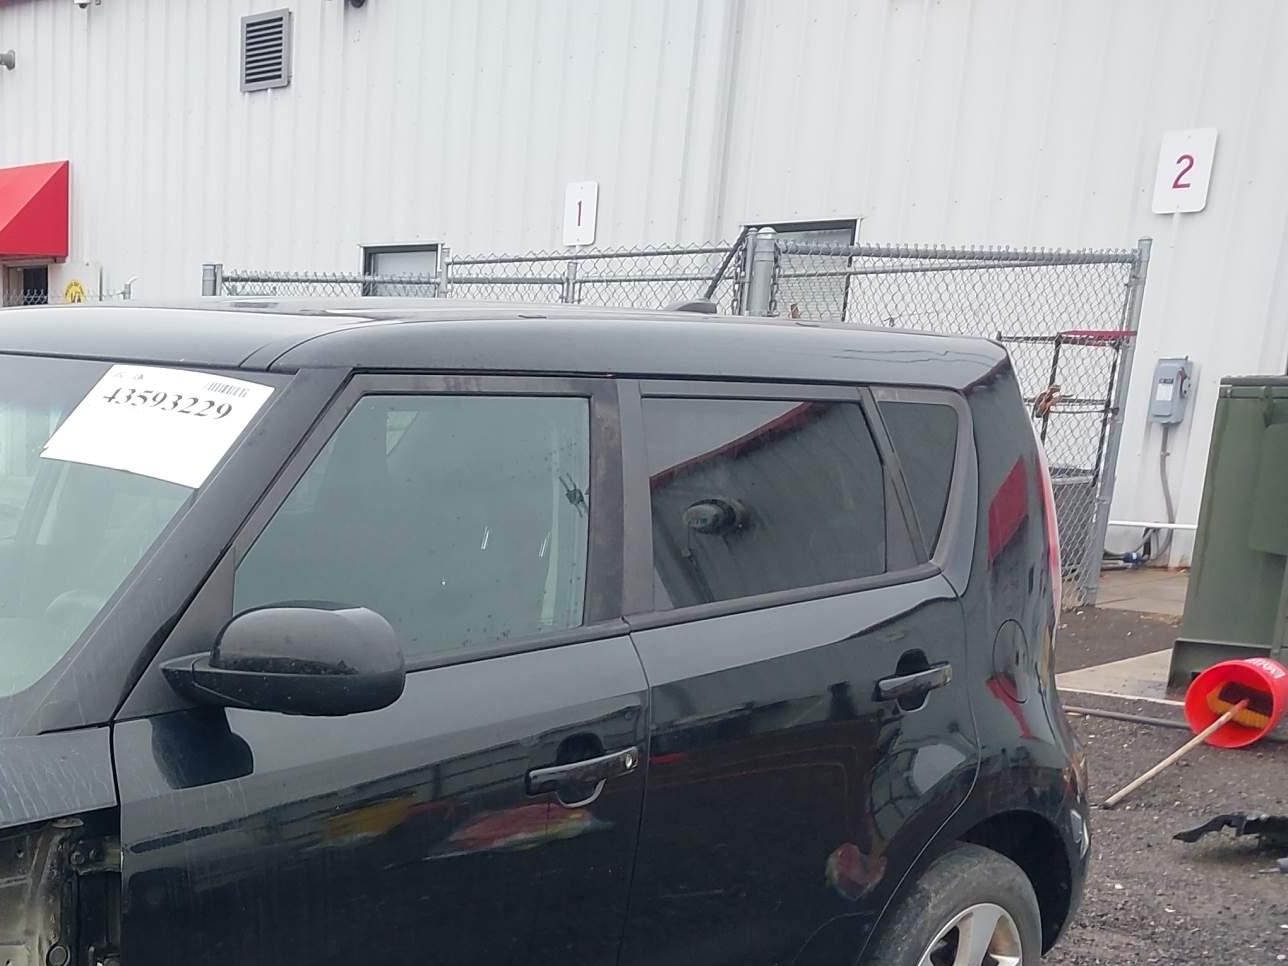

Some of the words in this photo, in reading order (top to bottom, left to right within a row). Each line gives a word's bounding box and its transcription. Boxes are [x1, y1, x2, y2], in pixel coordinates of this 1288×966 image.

[1172, 154, 1194, 189] 2
[577, 200, 582, 227] 1
[103, 387, 233, 420] 43593229
